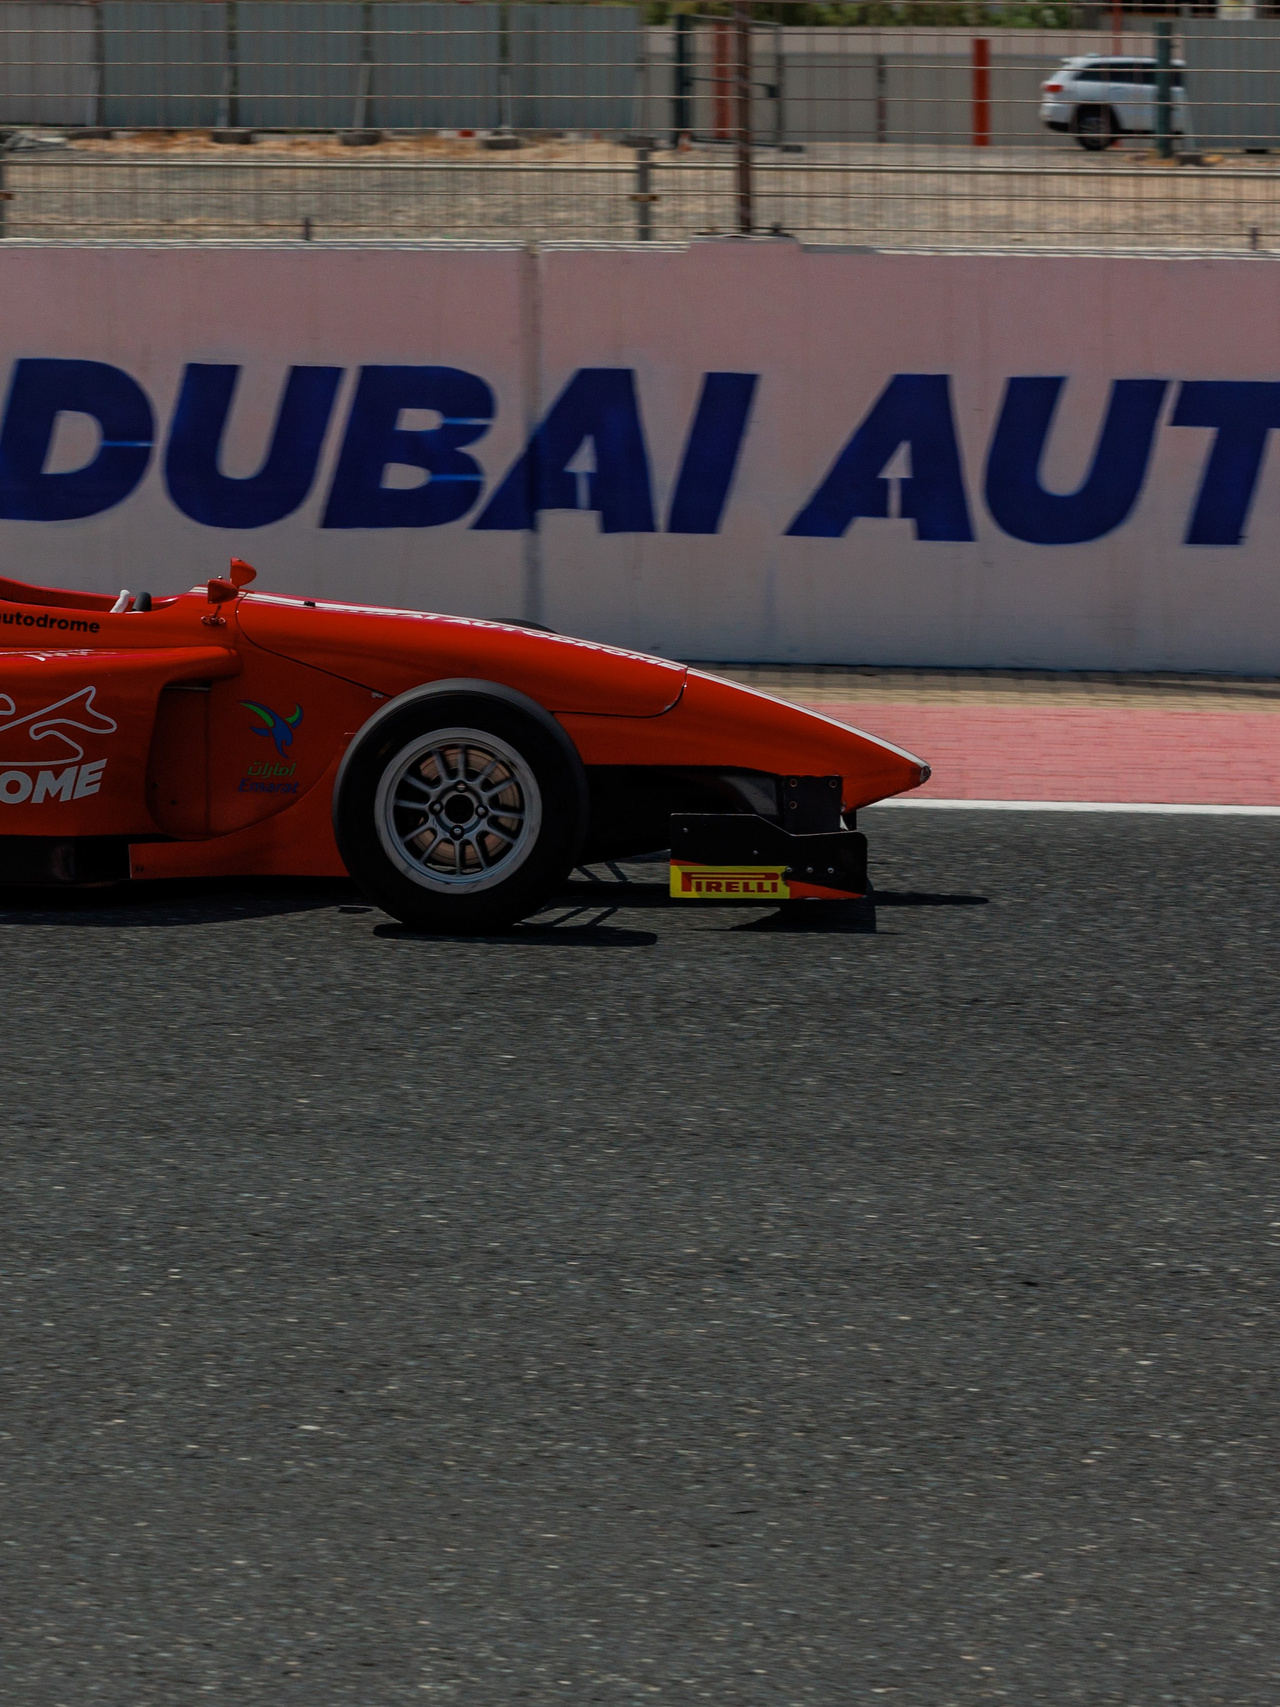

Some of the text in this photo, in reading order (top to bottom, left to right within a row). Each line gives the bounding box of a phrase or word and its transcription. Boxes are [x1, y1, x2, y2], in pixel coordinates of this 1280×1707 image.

[782, 373, 1280, 547] AUT
[441, 617, 687, 673] AUTODROME
[238, 778, 300, 794] Emarat
[681, 871, 780, 894] PIRELLI
